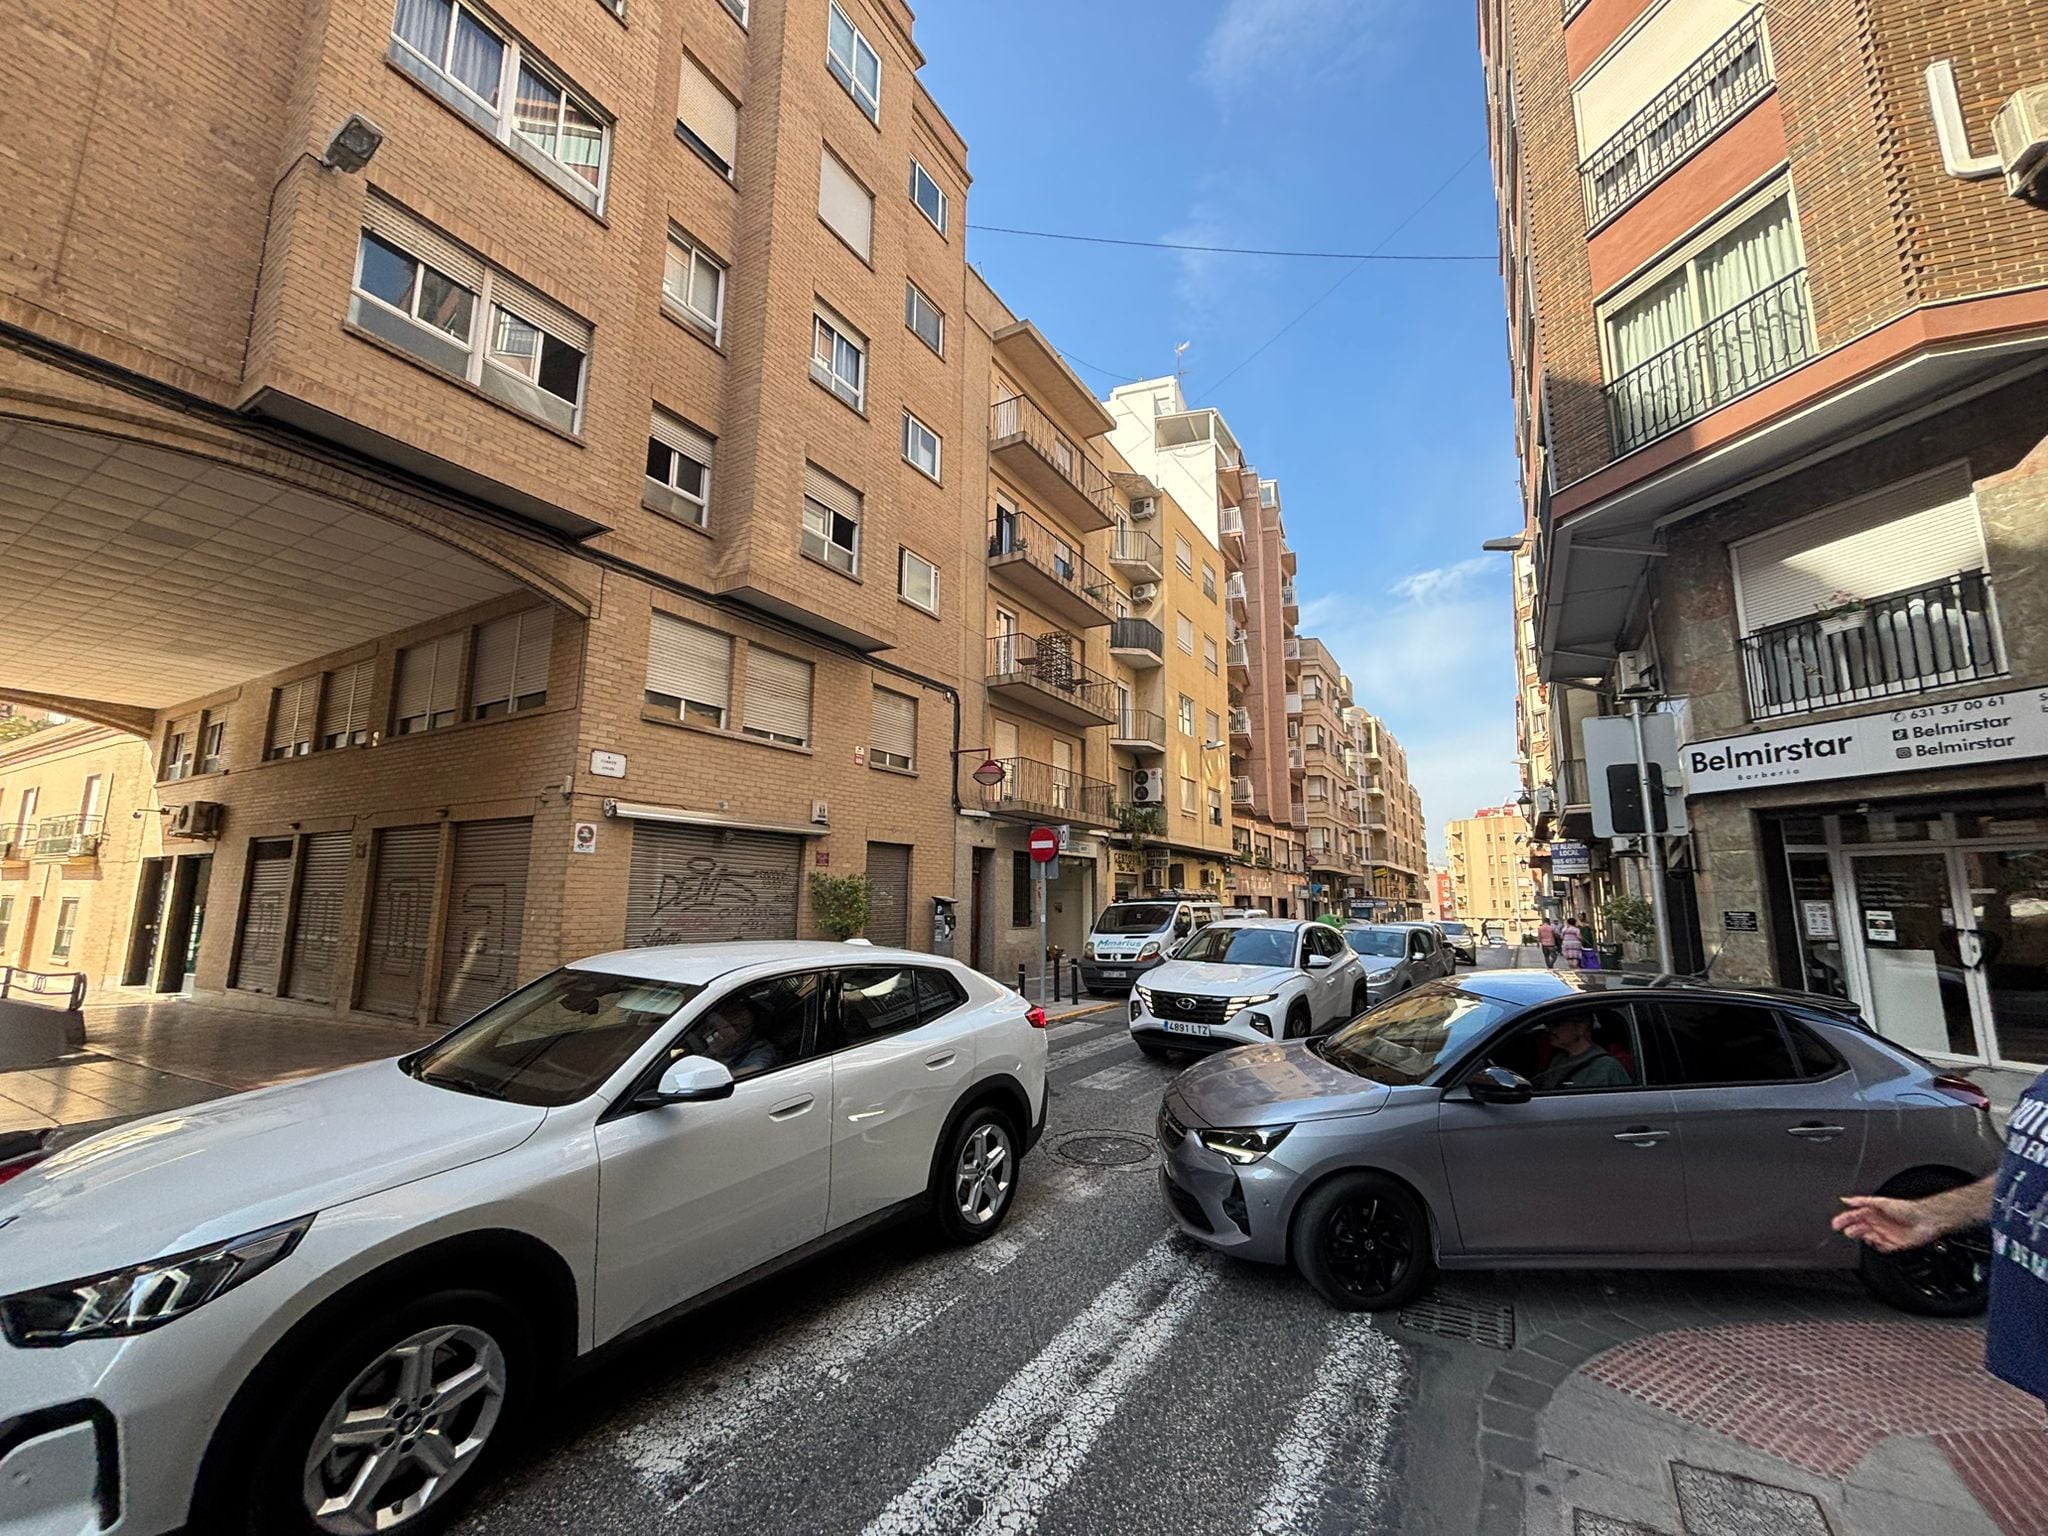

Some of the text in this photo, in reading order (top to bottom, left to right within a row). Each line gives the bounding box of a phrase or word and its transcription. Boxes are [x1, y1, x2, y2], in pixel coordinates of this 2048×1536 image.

[1910, 696, 2005, 719] 631 37 00 61
[1913, 716, 2012, 738] Belmirstar
[1691, 735, 1852, 774] Belmirstar
[1916, 736, 2015, 757] Belmirstar
[1169, 1023, 1208, 1035] 4891 LTZ
